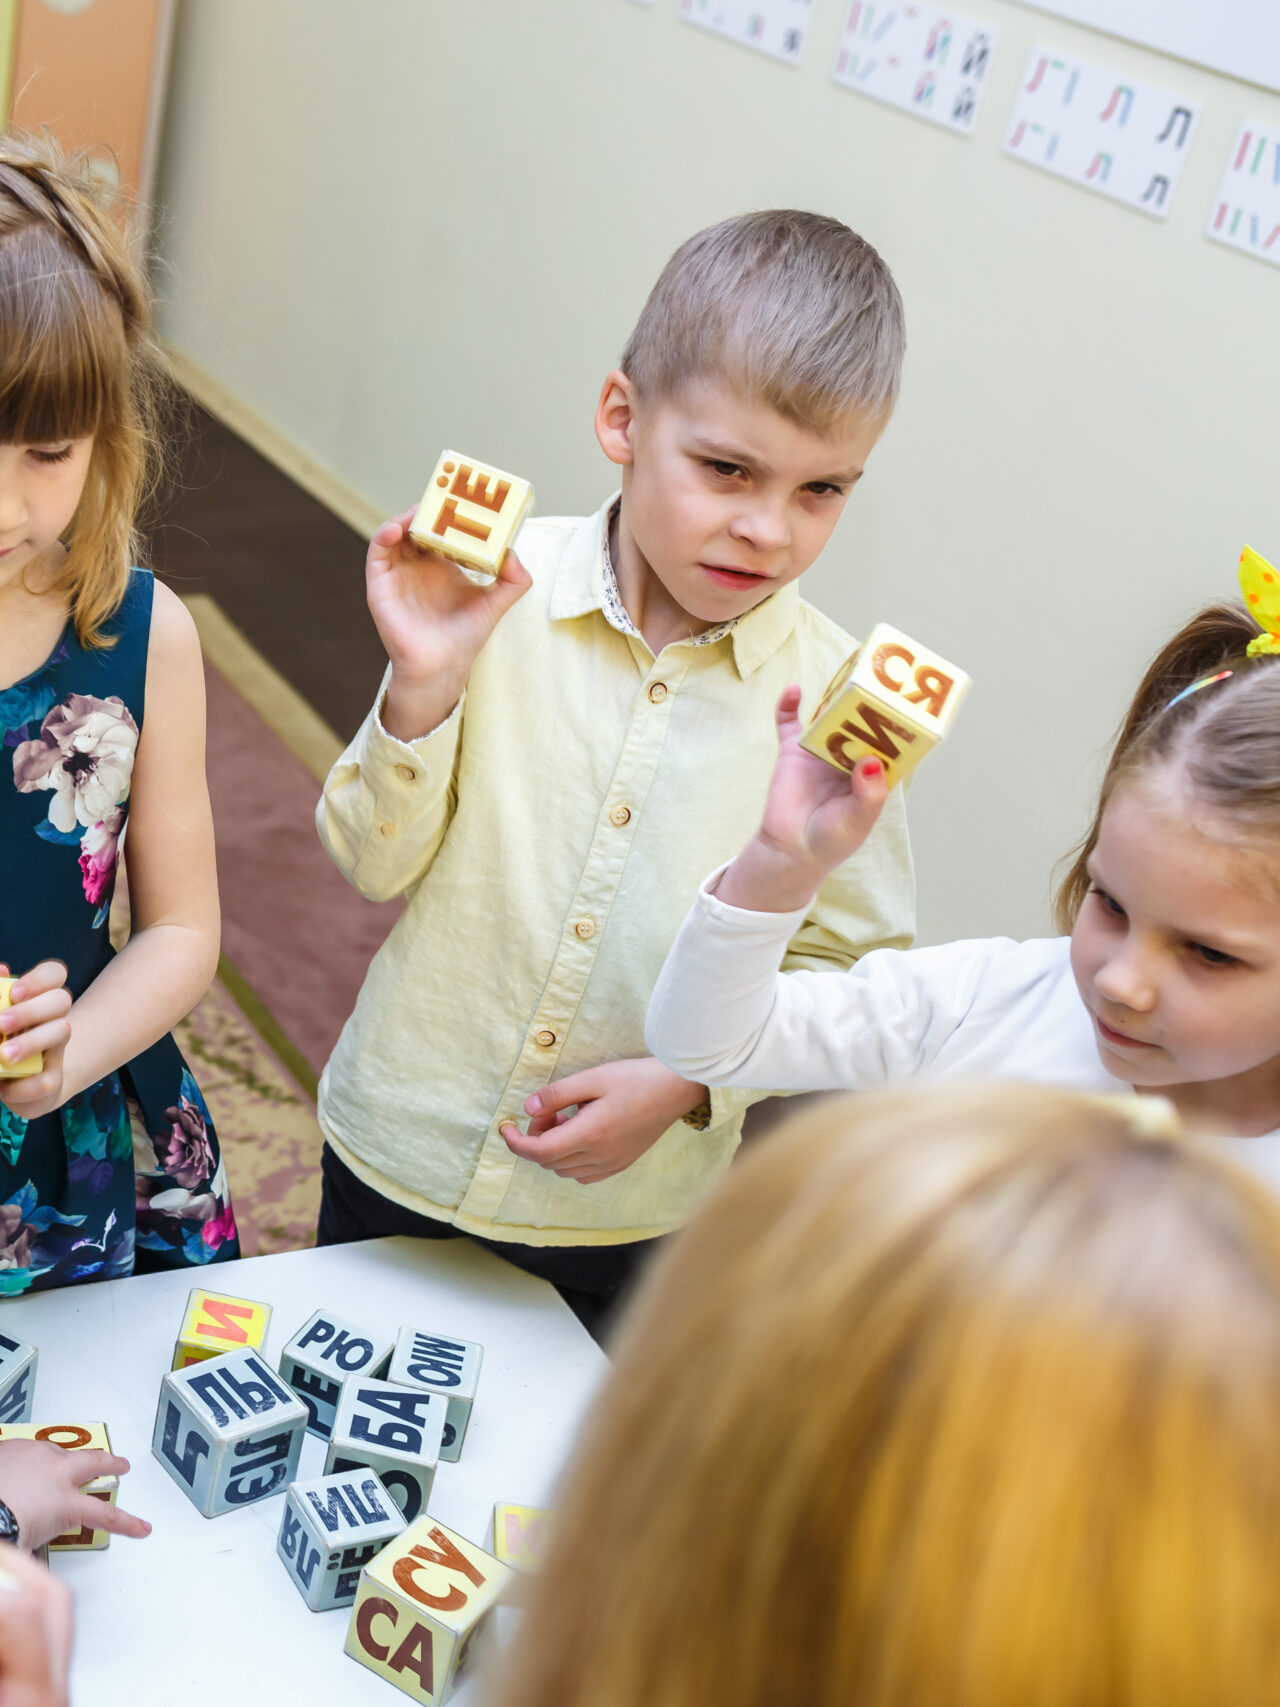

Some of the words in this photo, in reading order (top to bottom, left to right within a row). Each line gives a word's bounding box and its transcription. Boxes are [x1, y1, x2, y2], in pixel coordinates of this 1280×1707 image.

[431, 461, 512, 542] ТЁ
[872, 643, 954, 718] СЯ
[826, 702, 917, 772] СИ
[297, 1318, 375, 1371] РЮ
[407, 1332, 466, 1387] МЮ
[186, 1358, 292, 1428] ЛЫ
[350, 1389, 430, 1454] БА
[225, 1430, 293, 1504] ЛЭ
[305, 1479, 390, 1532] ЛИ
[280, 1504, 320, 1590] ЛЯ
[392, 1526, 486, 1612] СУ
[355, 1596, 434, 1695] СА
